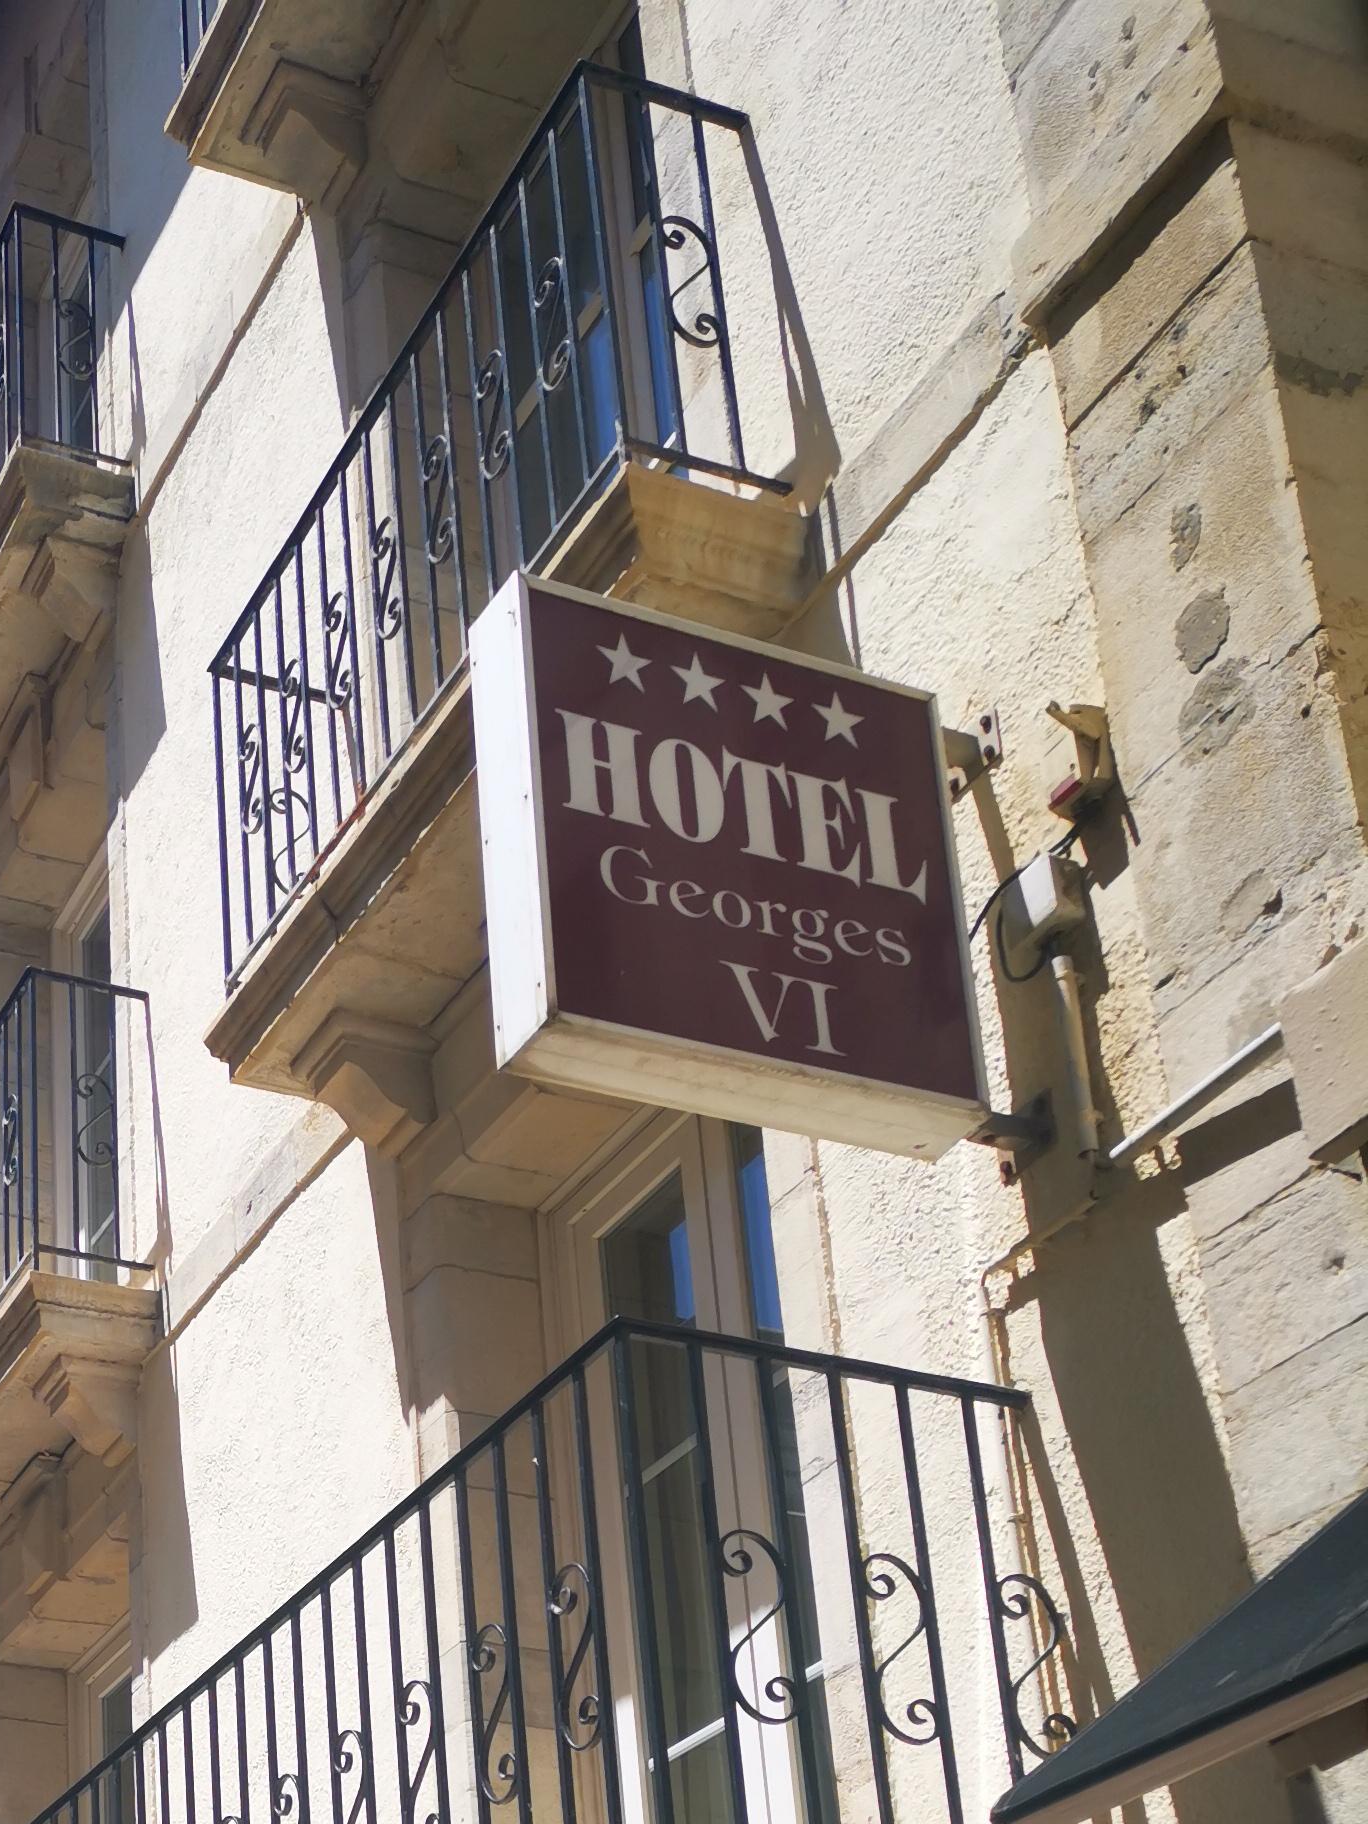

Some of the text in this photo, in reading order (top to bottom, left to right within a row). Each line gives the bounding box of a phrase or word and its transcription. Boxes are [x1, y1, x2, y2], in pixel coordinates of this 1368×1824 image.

[554, 708, 927, 906] HOTEL
[599, 844, 912, 966] Georges
[720, 959, 848, 1057] VI
